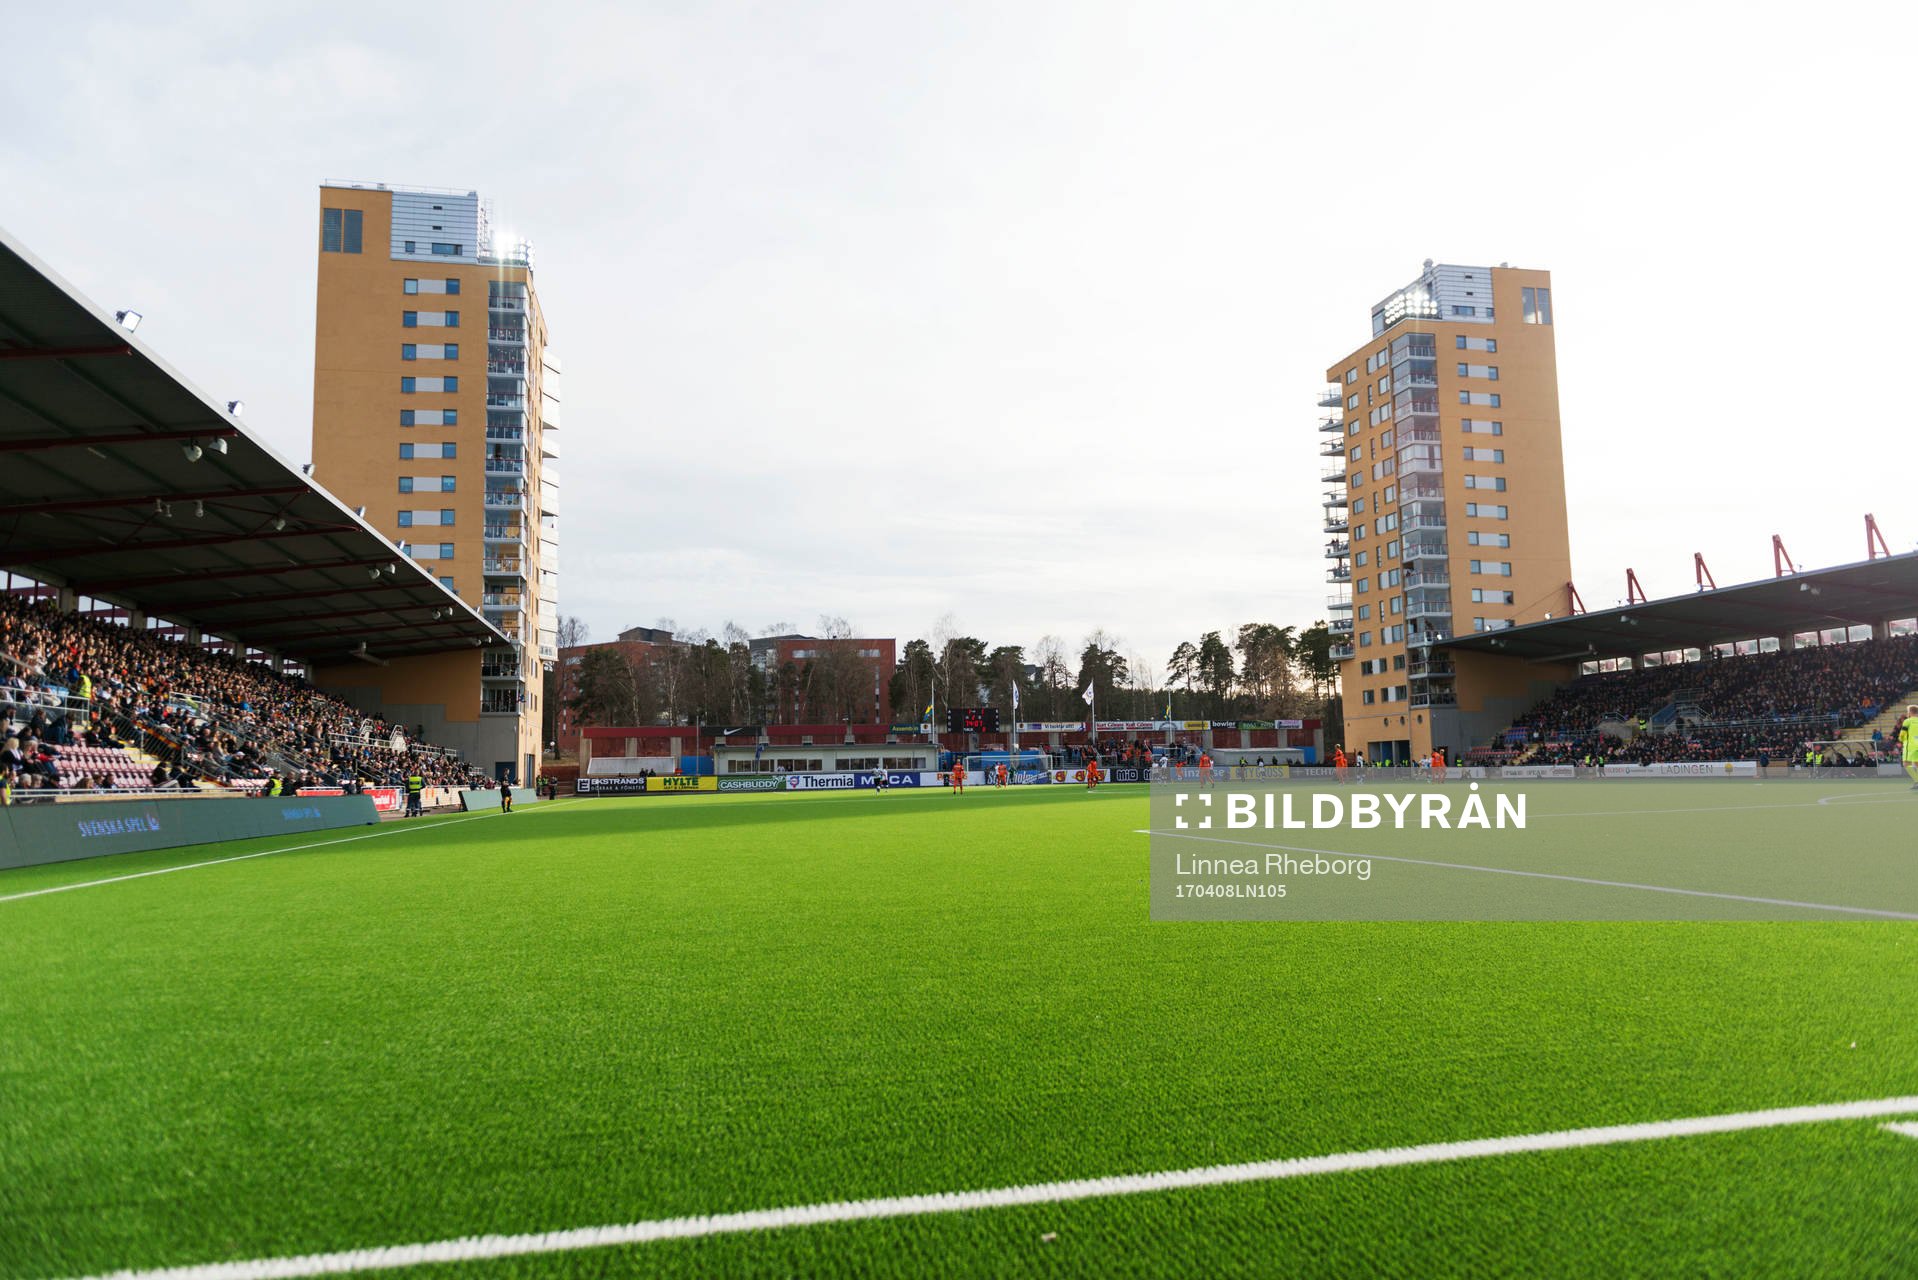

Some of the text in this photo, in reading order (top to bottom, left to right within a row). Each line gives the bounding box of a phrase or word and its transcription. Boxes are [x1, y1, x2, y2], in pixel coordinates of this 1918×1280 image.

[1212, 720, 1236, 728] bowler
[1660, 764, 1714, 775] LADINGEN
[591, 777, 645, 785] EKSTRANDS
[663, 777, 699, 786] HYLTE
[719, 779, 777, 790] CASHBUDDY
[803, 775, 854, 788] Thermia
[861, 775, 913, 785] MCA
[78, 817, 148, 837] SVENSKA SPEL
